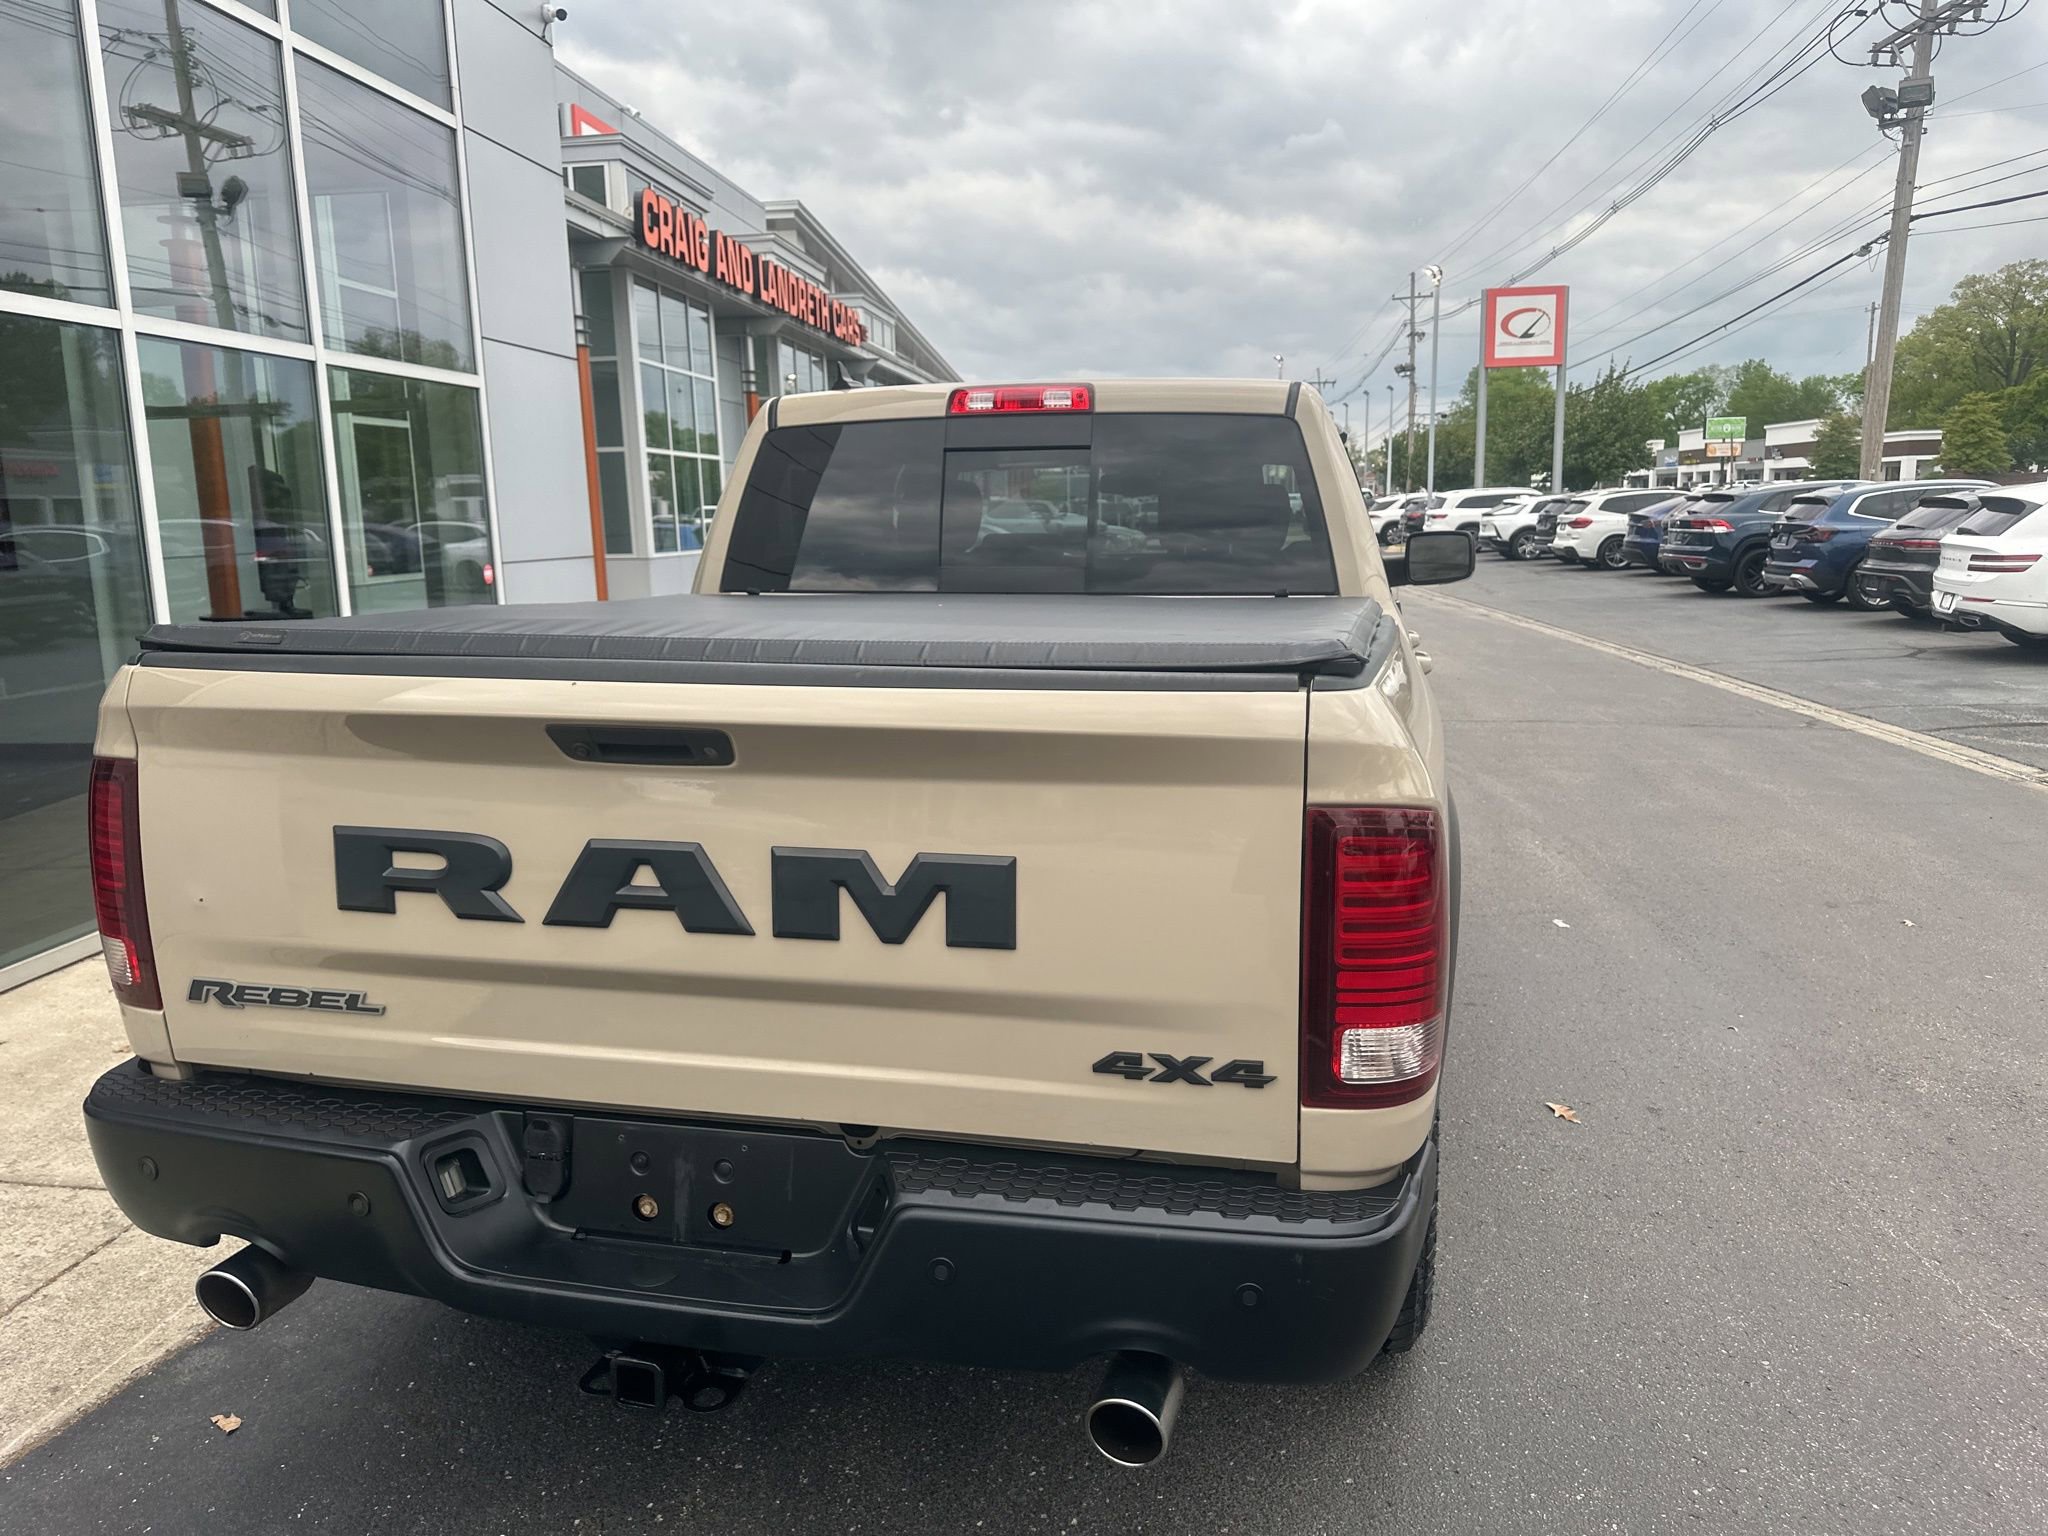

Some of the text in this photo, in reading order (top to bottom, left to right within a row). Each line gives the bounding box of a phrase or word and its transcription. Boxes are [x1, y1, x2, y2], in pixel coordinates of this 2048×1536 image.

[639, 187, 863, 347] CRAIG AND LANDRETH CARS
[333, 825, 1017, 950] RAM
[187, 977, 386, 1016] REBEL
[1092, 1051, 1278, 1089] 4X4
